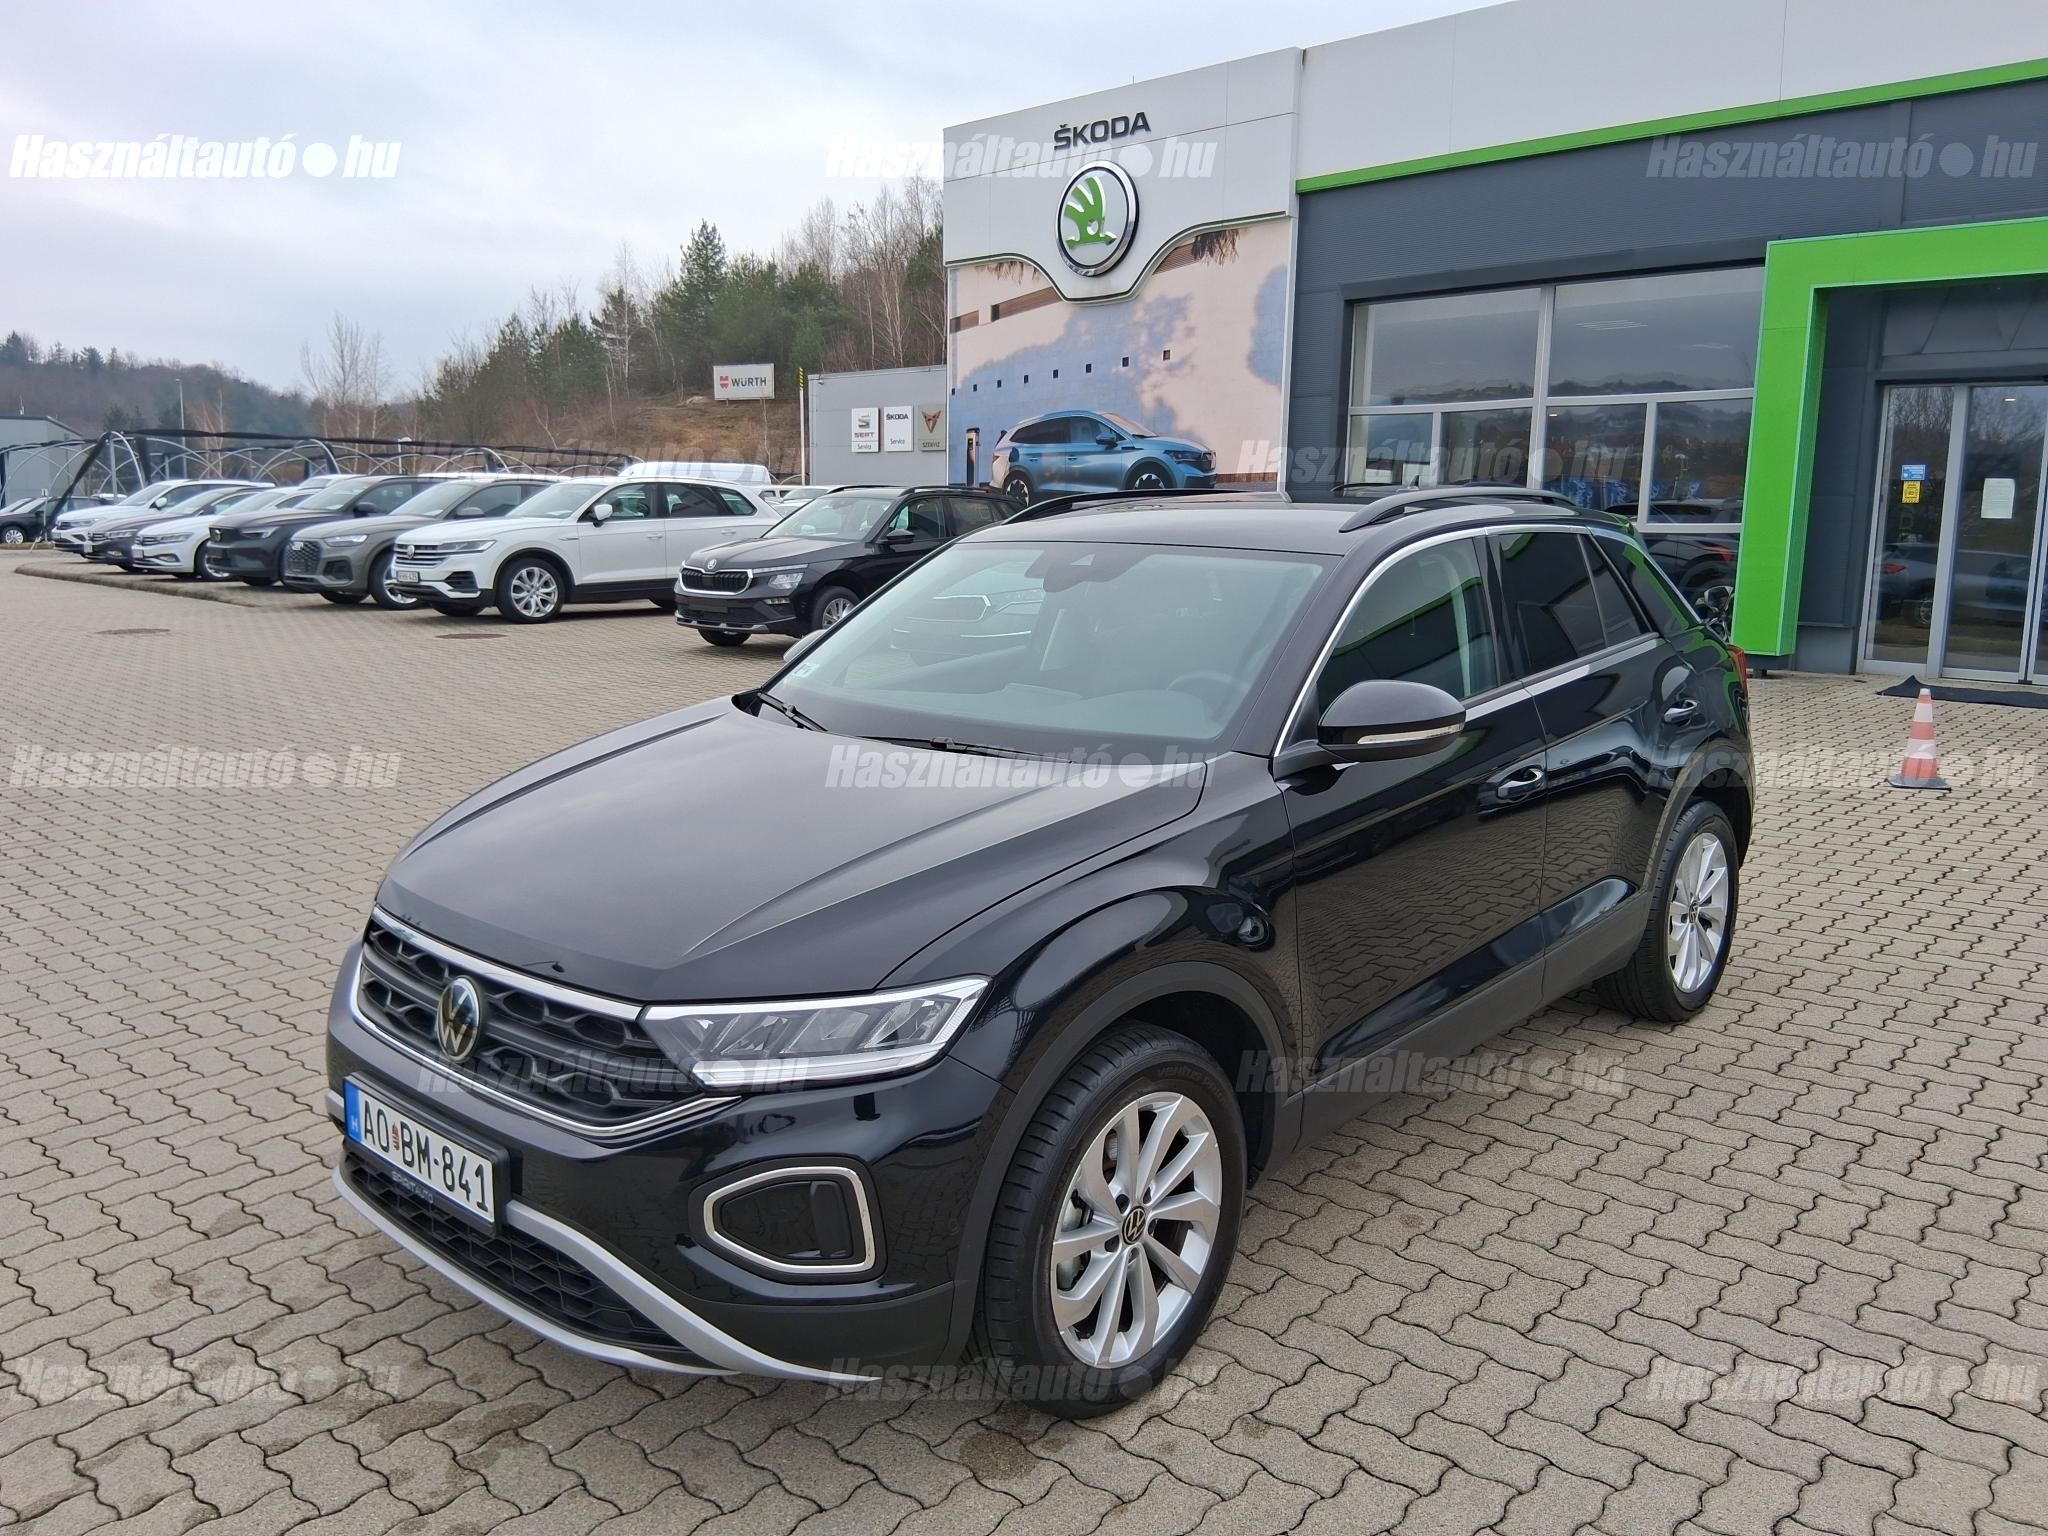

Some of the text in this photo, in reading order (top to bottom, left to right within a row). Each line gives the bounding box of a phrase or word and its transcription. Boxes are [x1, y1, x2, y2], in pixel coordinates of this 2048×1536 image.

[1054, 112, 1151, 150] ŠKODA
[731, 376, 767, 387] WÜRTH
[886, 413, 908, 421] ŠKODA
[351, 1116, 359, 1132] H
